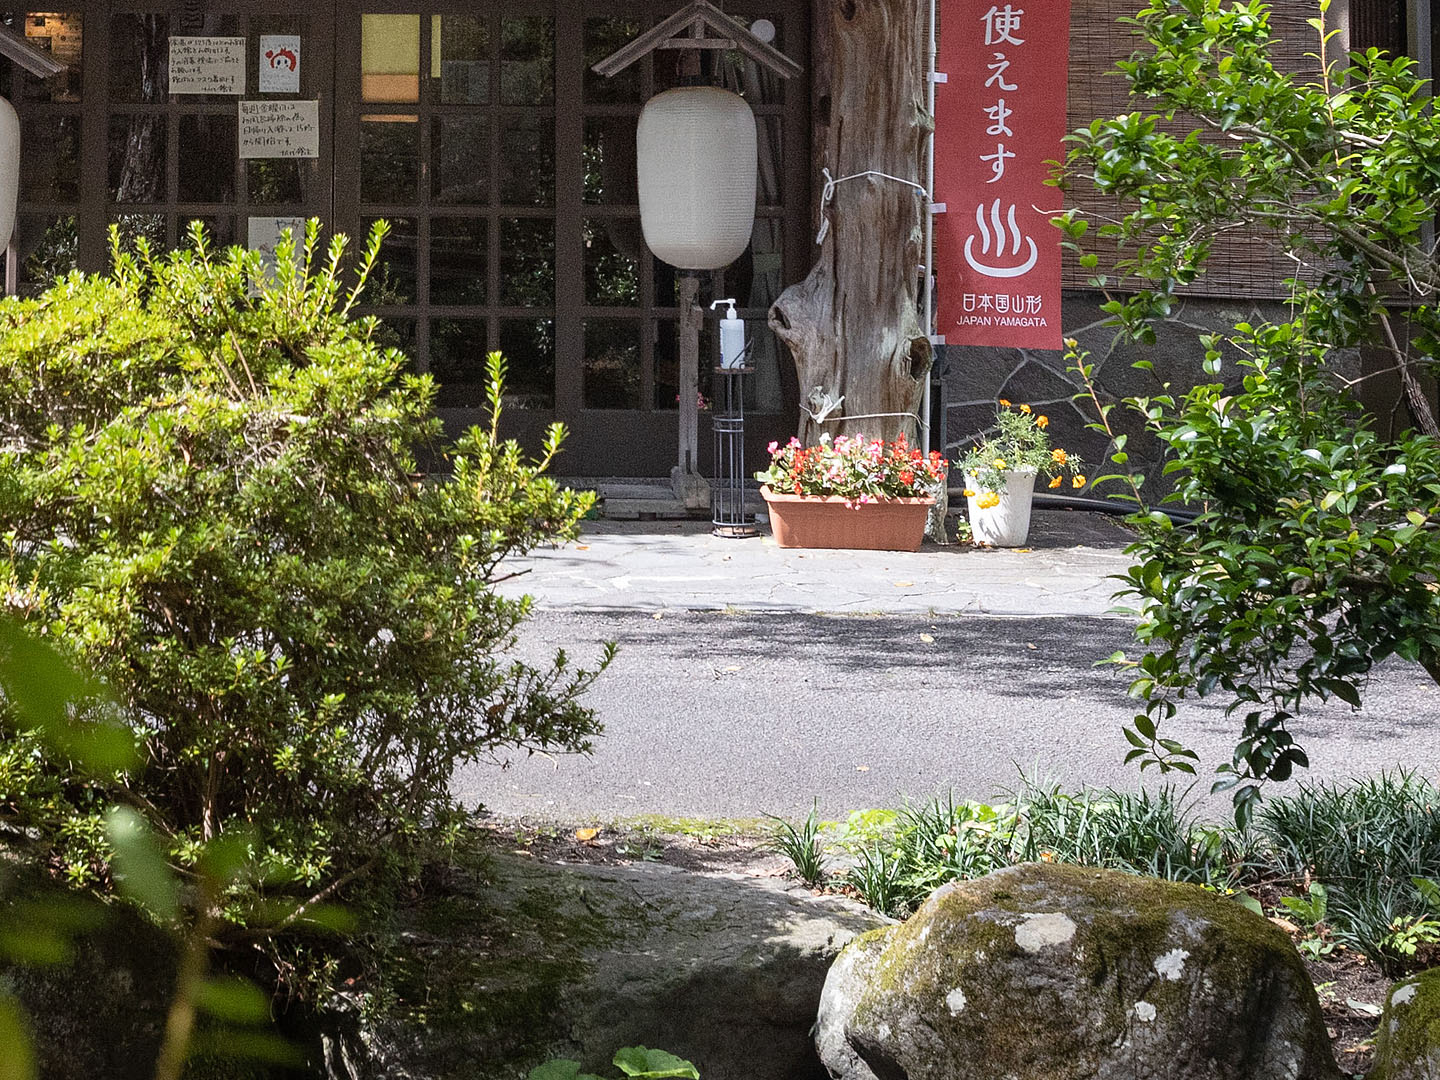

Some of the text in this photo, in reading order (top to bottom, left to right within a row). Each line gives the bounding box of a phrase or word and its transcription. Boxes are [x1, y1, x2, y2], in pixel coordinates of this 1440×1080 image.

[979, 4, 1027, 184] 使えます
[962, 293, 1042, 315] 日本国山形
[956, 316, 1048, 328] JAPAN YAMAGATA
